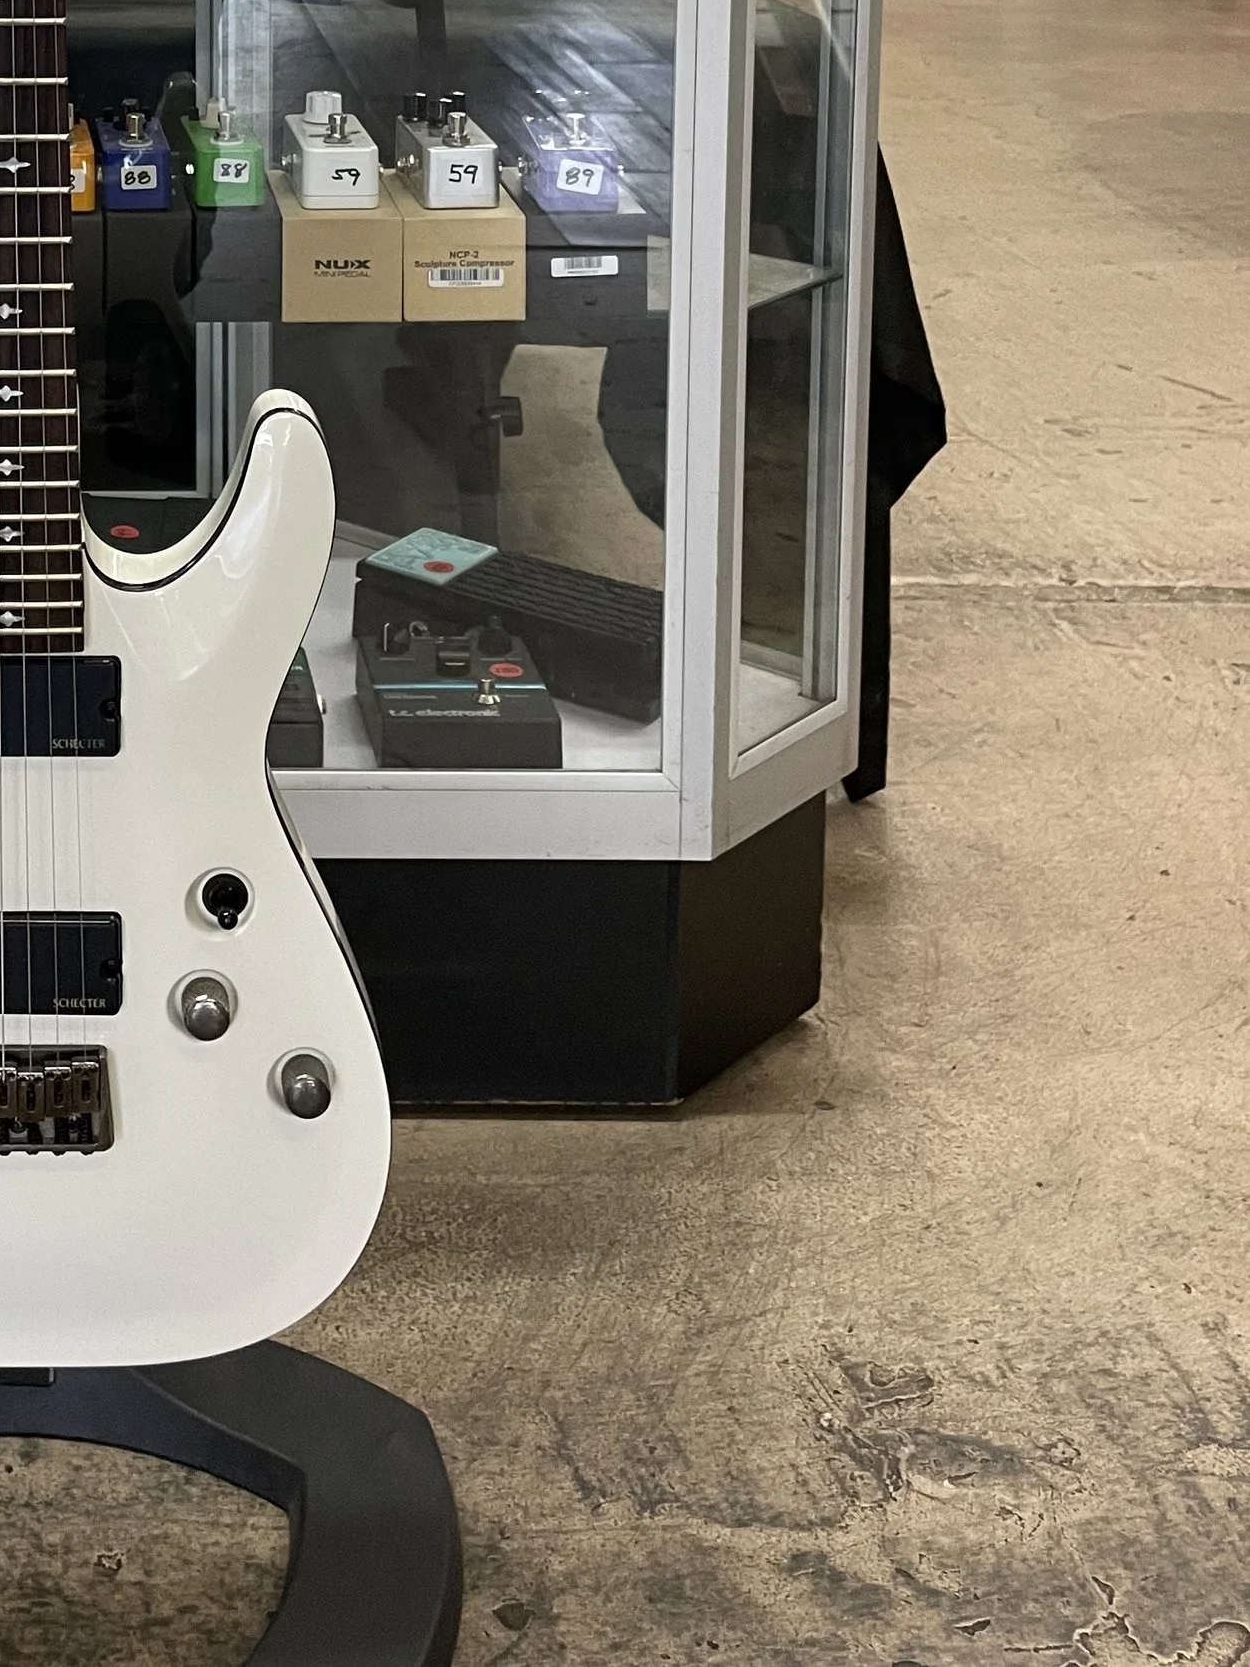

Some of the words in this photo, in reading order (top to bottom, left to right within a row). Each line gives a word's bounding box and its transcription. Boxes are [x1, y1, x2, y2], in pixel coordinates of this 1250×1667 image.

[220, 162, 248, 179] 88
[331, 167, 361, 186] 59
[449, 164, 479, 184] 59
[565, 167, 595, 186] 89
[124, 171, 151, 185] 88
[449, 250, 480, 260] NCP-2
[314, 258, 372, 270] NUX
[414, 259, 457, 269] Sculpture
[458, 259, 515, 269] Compressor
[52, 738, 106, 750] SCHECTER
[52, 998, 107, 1009] SCHECTER
